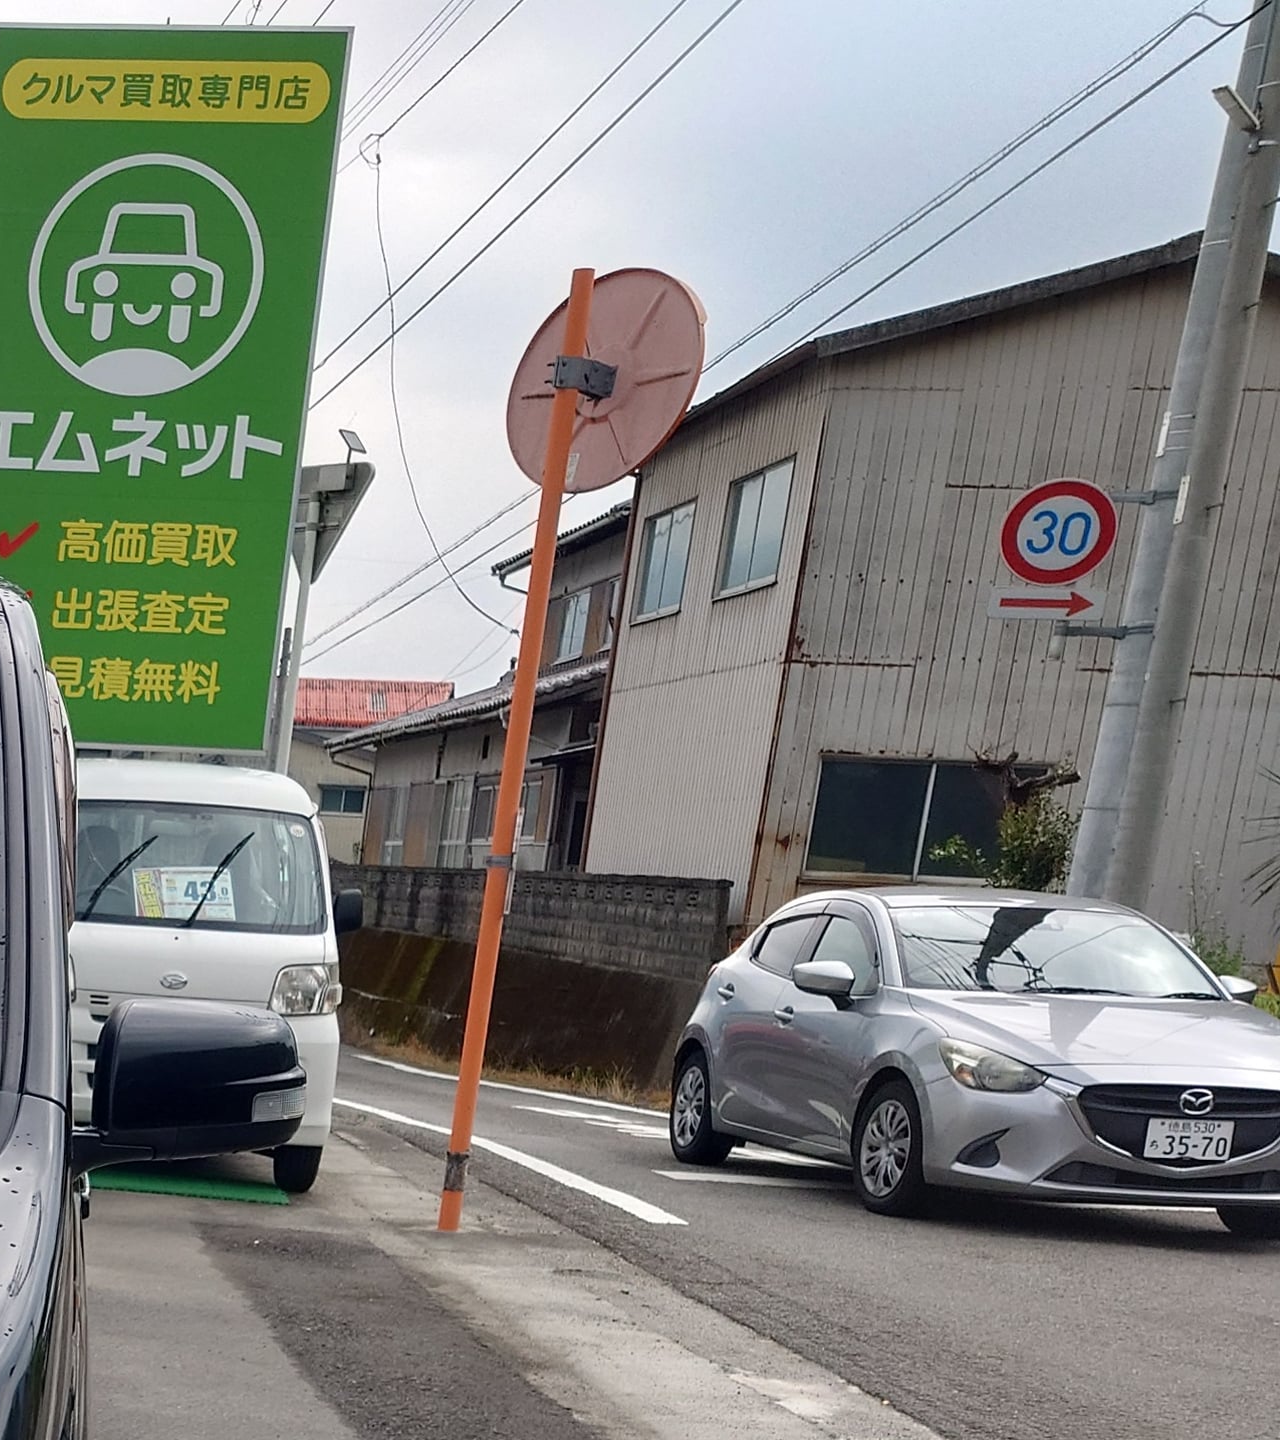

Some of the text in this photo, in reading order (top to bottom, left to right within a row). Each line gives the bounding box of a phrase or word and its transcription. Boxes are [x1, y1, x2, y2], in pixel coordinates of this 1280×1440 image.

[22, 72, 311, 110] クルマ買取専門店
[57, 519, 238, 567] 高価買取
[1026, 510, 1092, 556] 30
[51, 588, 230, 635] 出張査定
[51, 656, 221, 704] 見積無料
[1162, 1135, 1228, 1157] 35-70
[1193, 1123, 1216, 1133] 530
